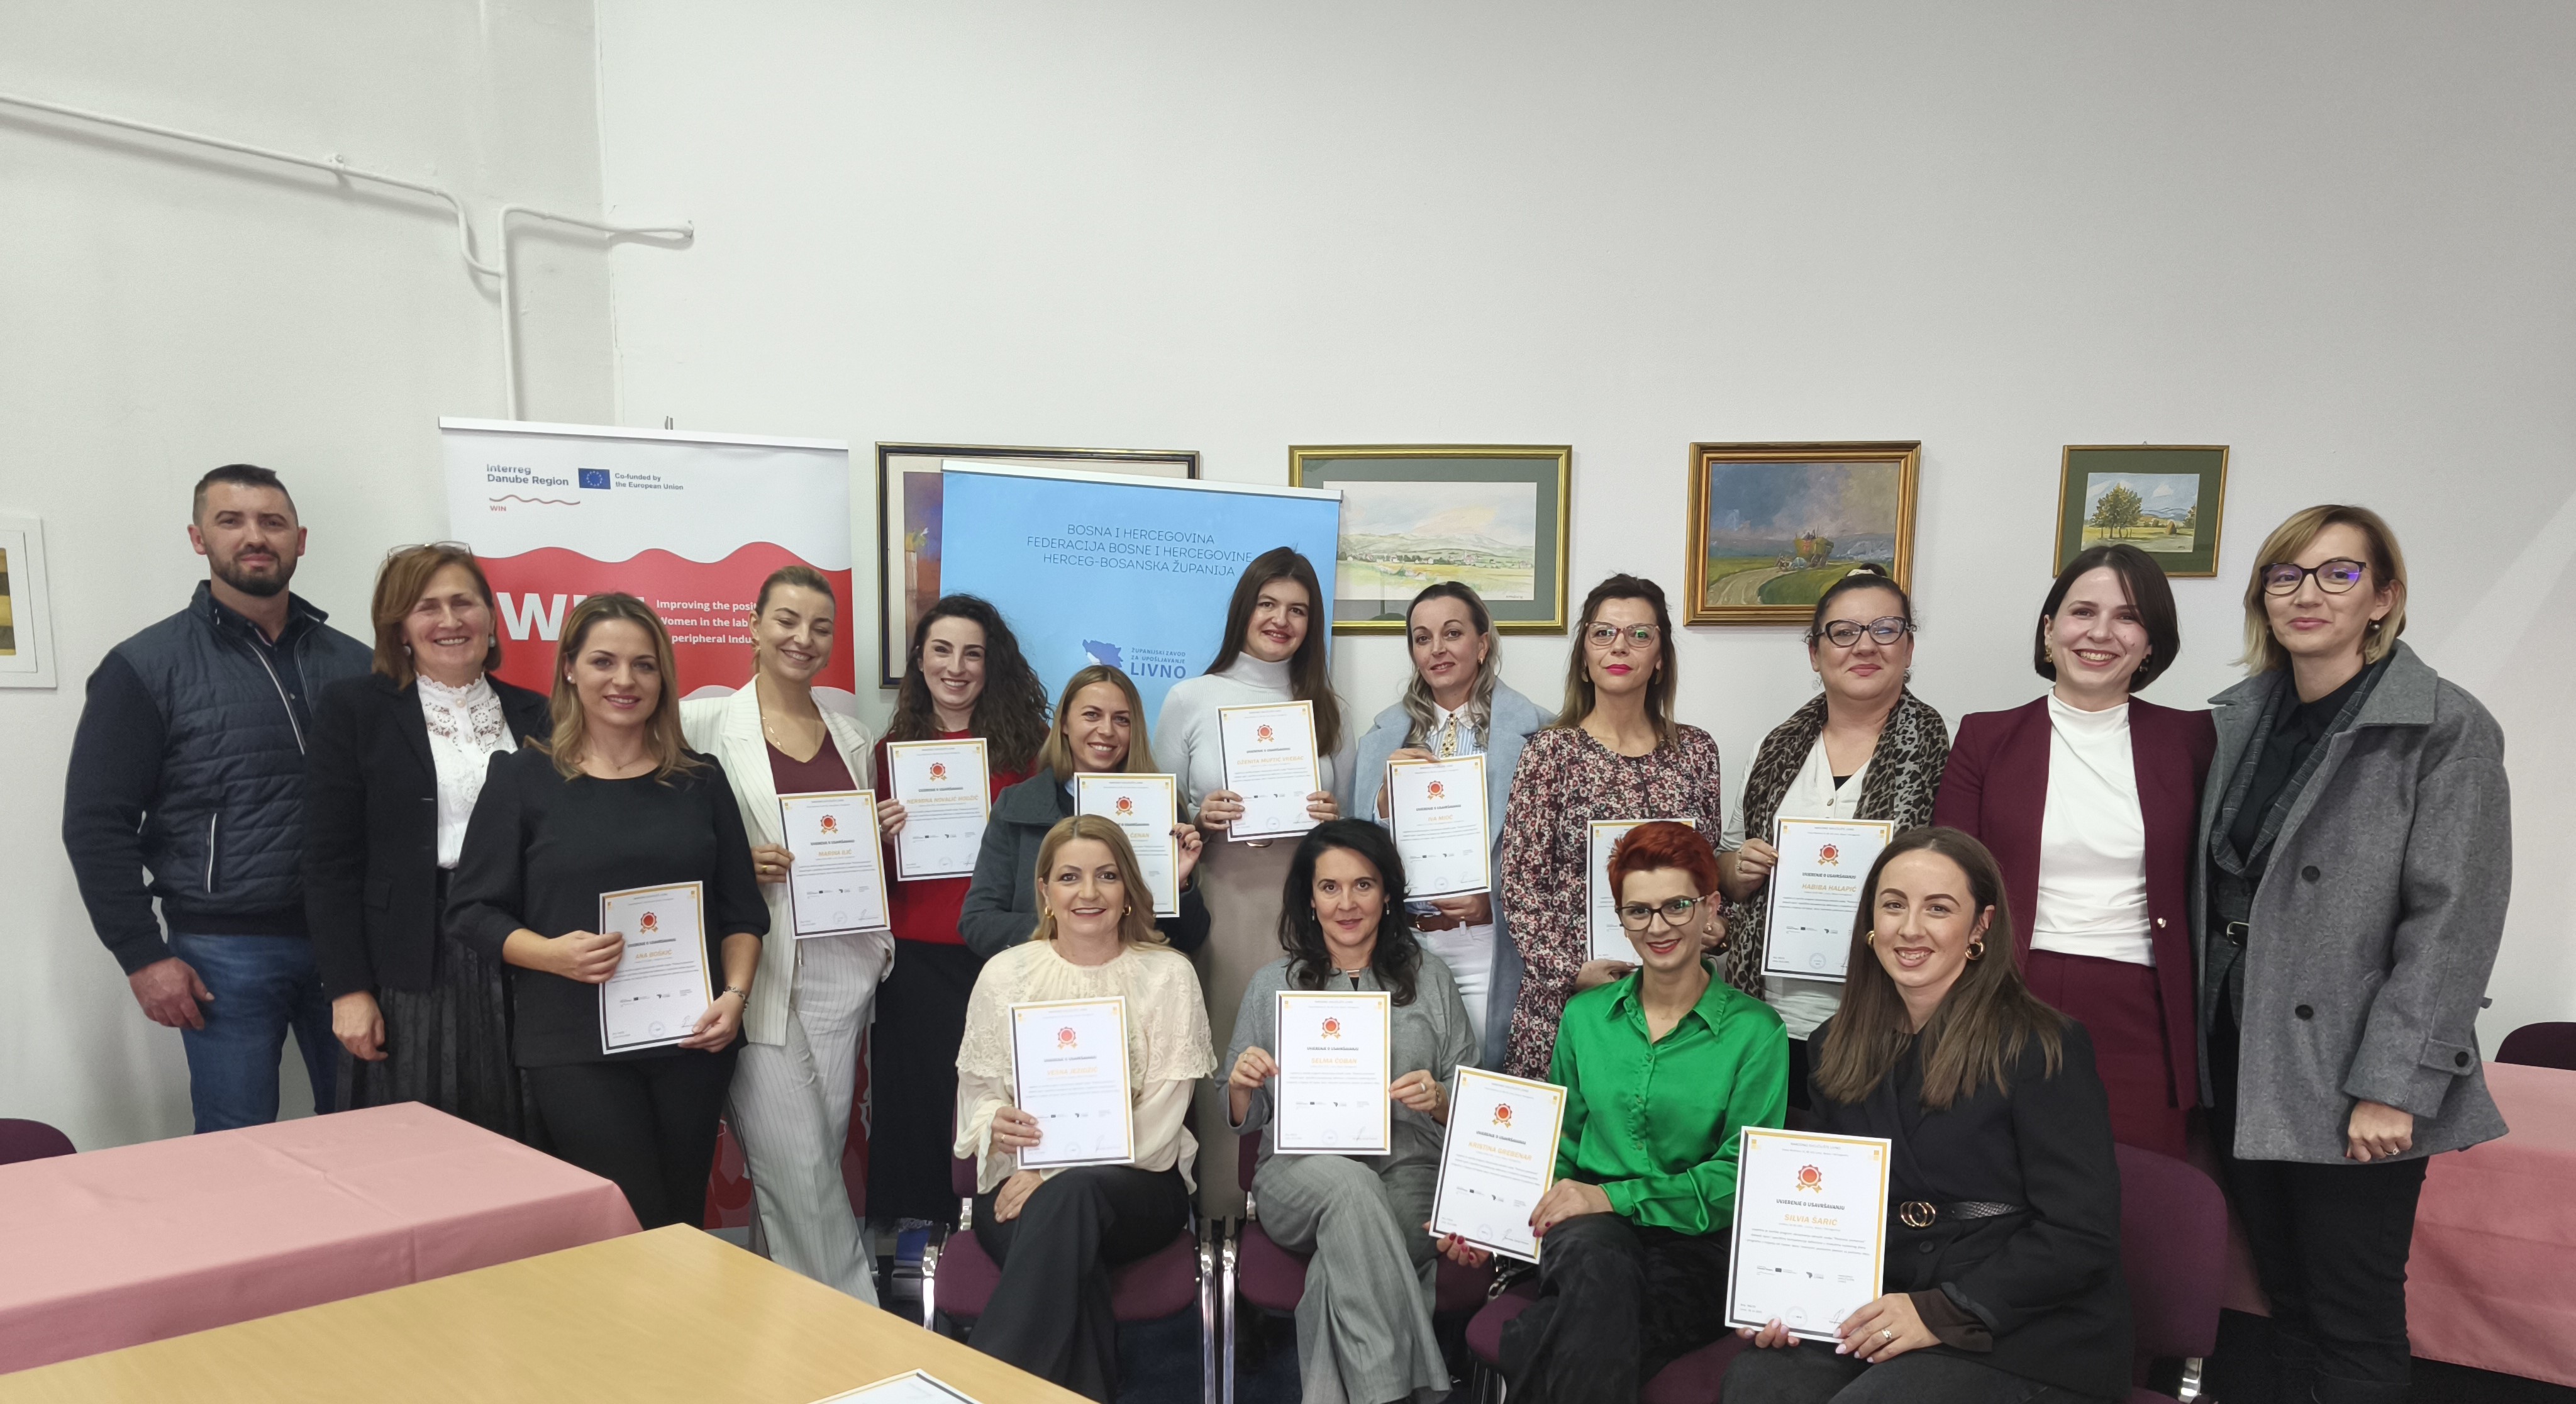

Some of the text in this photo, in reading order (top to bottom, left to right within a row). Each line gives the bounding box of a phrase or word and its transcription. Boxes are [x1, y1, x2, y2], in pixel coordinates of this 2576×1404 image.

[486, 464, 531, 475] Interreg
[487, 474, 569, 486] Danube Region
[614, 473, 651, 481] Co-funded
[628, 482, 662, 490] European
[1067, 524, 1215, 545] BOSNA I HERCEGOVINA
[1027, 536, 1252, 563] FEDERACIJA BOSNE I HERCEGOVINE
[1043, 553, 1235, 577] HERCEG-BOSANSKA ŽUPANIJA
[656, 599, 710, 612] Improving
[713, 601, 730, 610] the
[700, 617, 710, 626] in
[713, 618, 730, 627] the
[672, 634, 726, 644] peripheral
[1131, 662, 1186, 679] LIVNO
[1807, 1202, 1845, 1210] USAVRŠAVANJU
[1784, 1213, 1838, 1226] SILVIA ŠARIĆ
